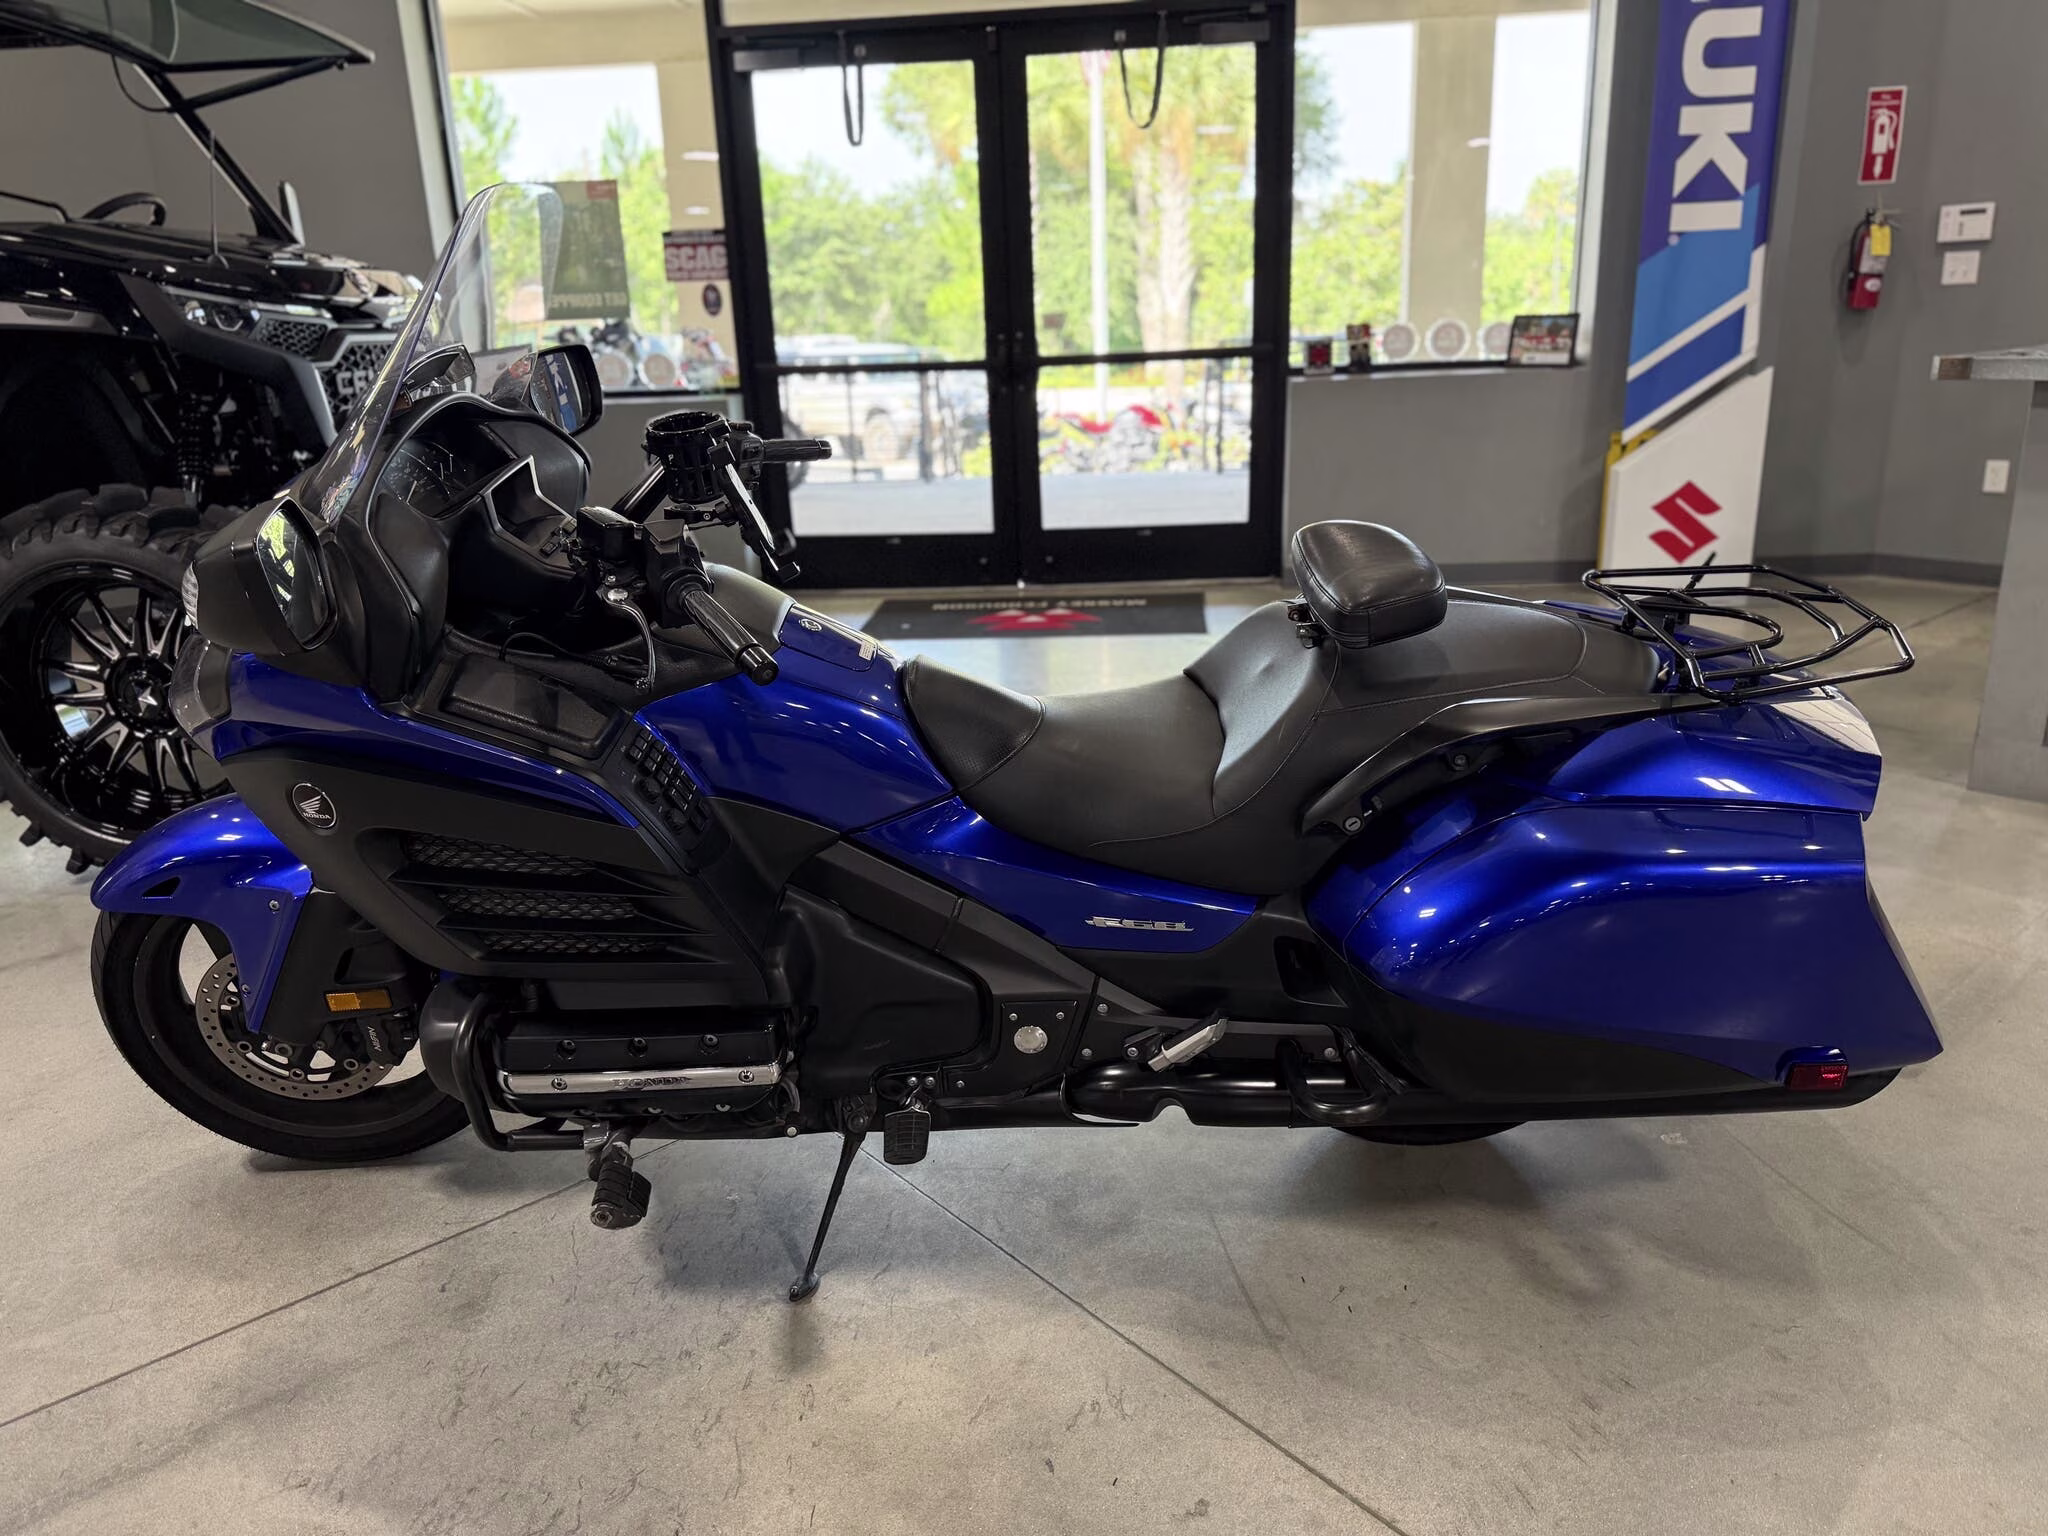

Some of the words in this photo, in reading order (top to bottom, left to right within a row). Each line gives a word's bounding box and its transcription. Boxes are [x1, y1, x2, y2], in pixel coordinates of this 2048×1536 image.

[1669, 0, 1763, 233] UKI
[665, 245, 728, 270] SCAG
[303, 811, 332, 820] HONDA
